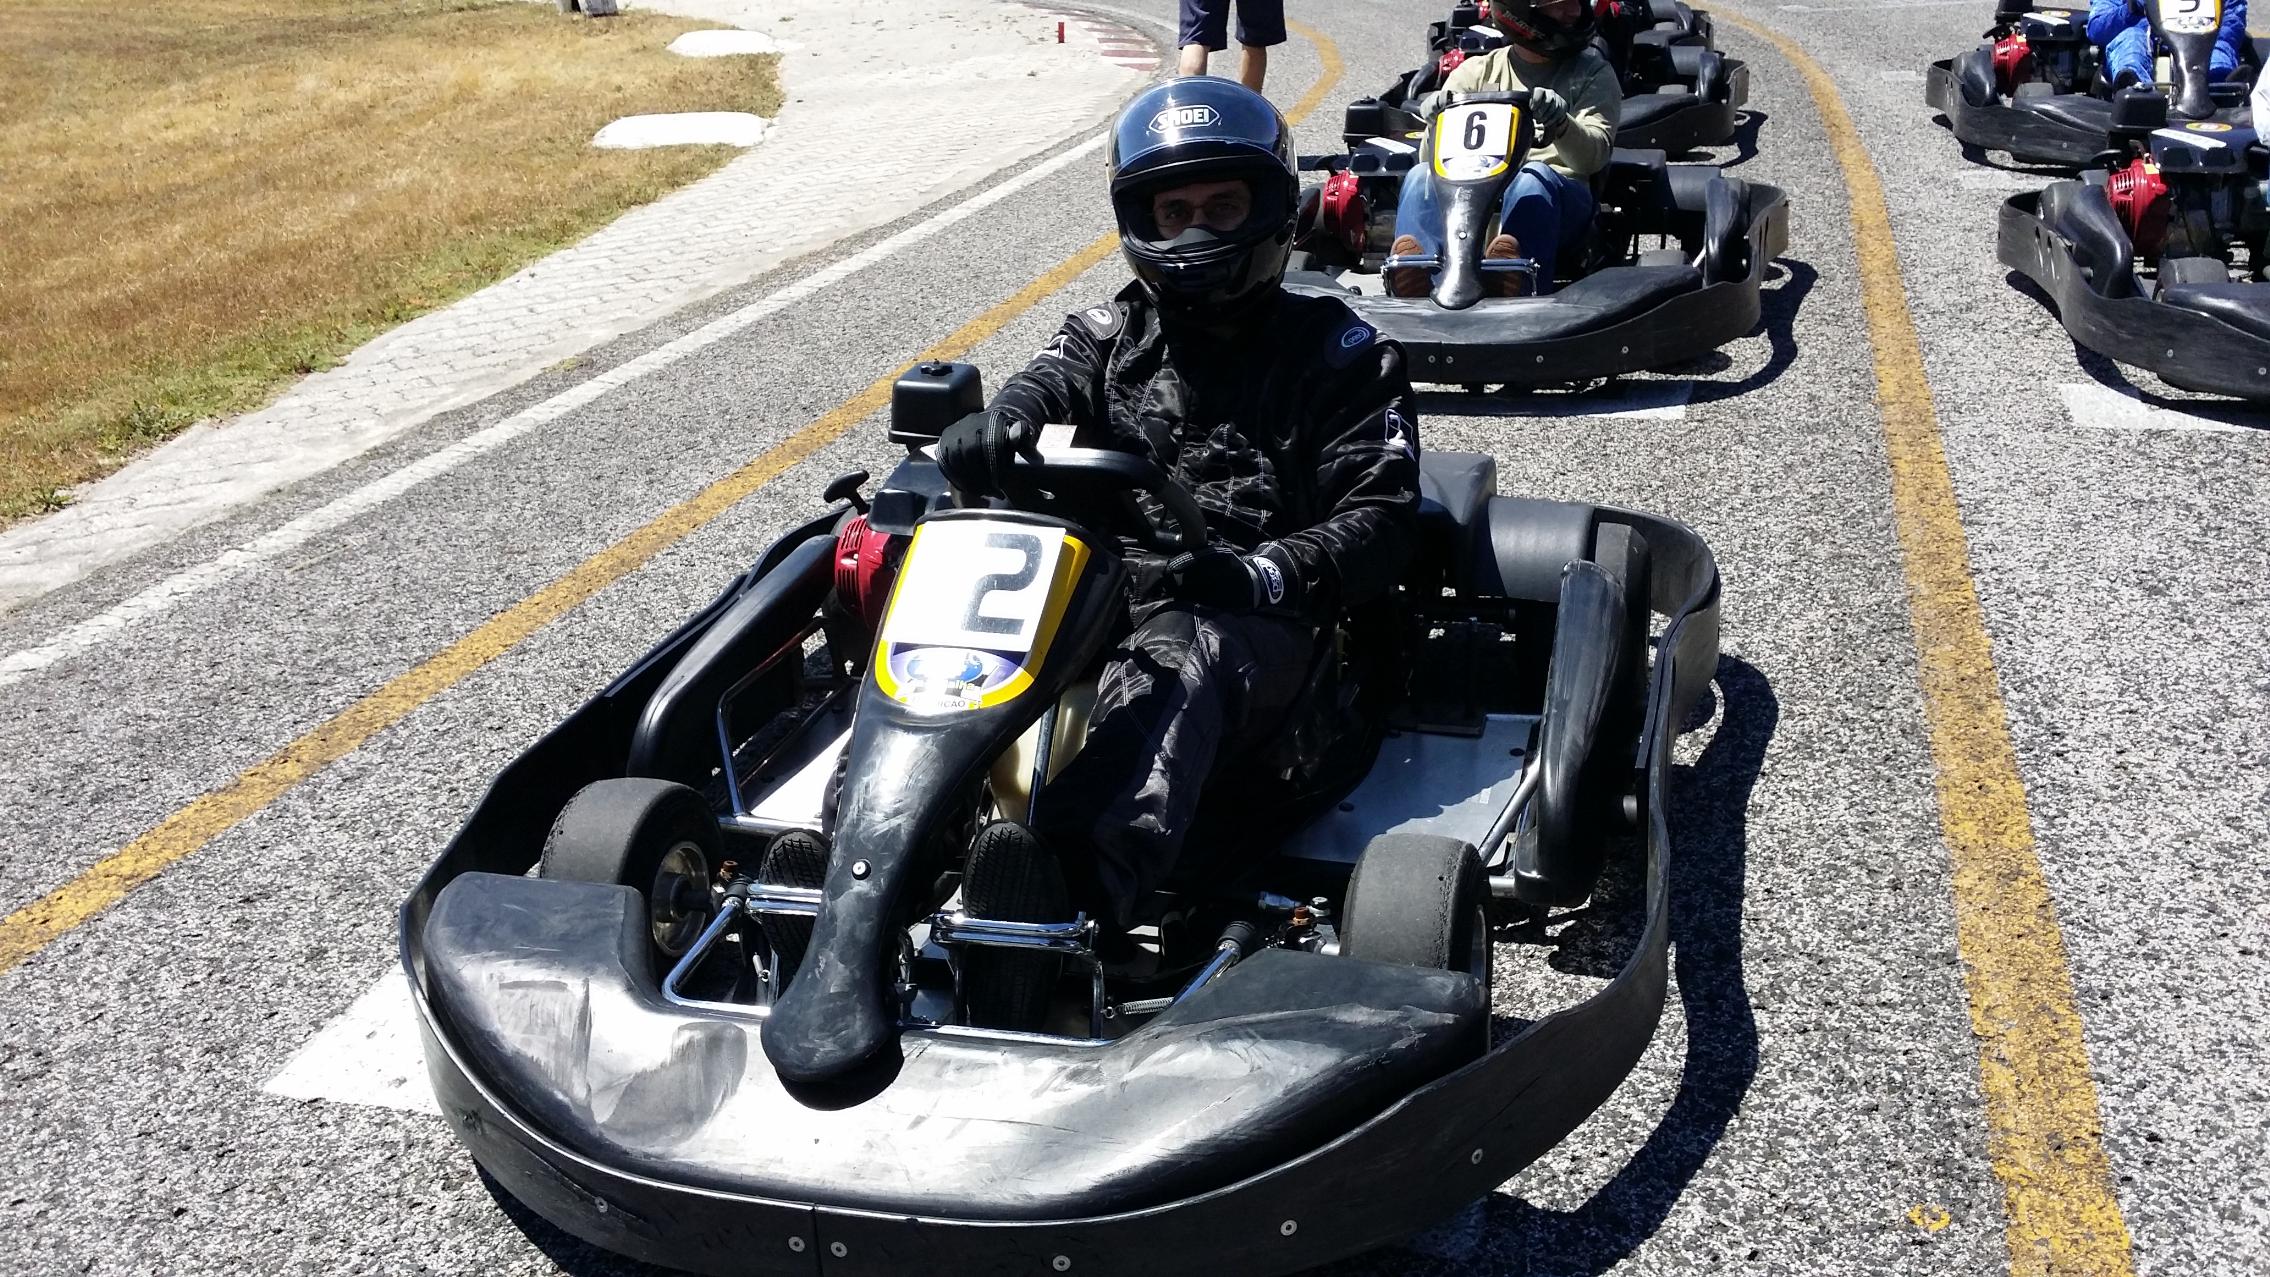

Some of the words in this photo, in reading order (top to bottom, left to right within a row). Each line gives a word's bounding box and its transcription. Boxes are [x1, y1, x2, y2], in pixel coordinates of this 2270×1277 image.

[1157, 108, 1210, 131] SHOEI
[1463, 110, 1488, 151] 6
[961, 532, 1044, 636] 2
